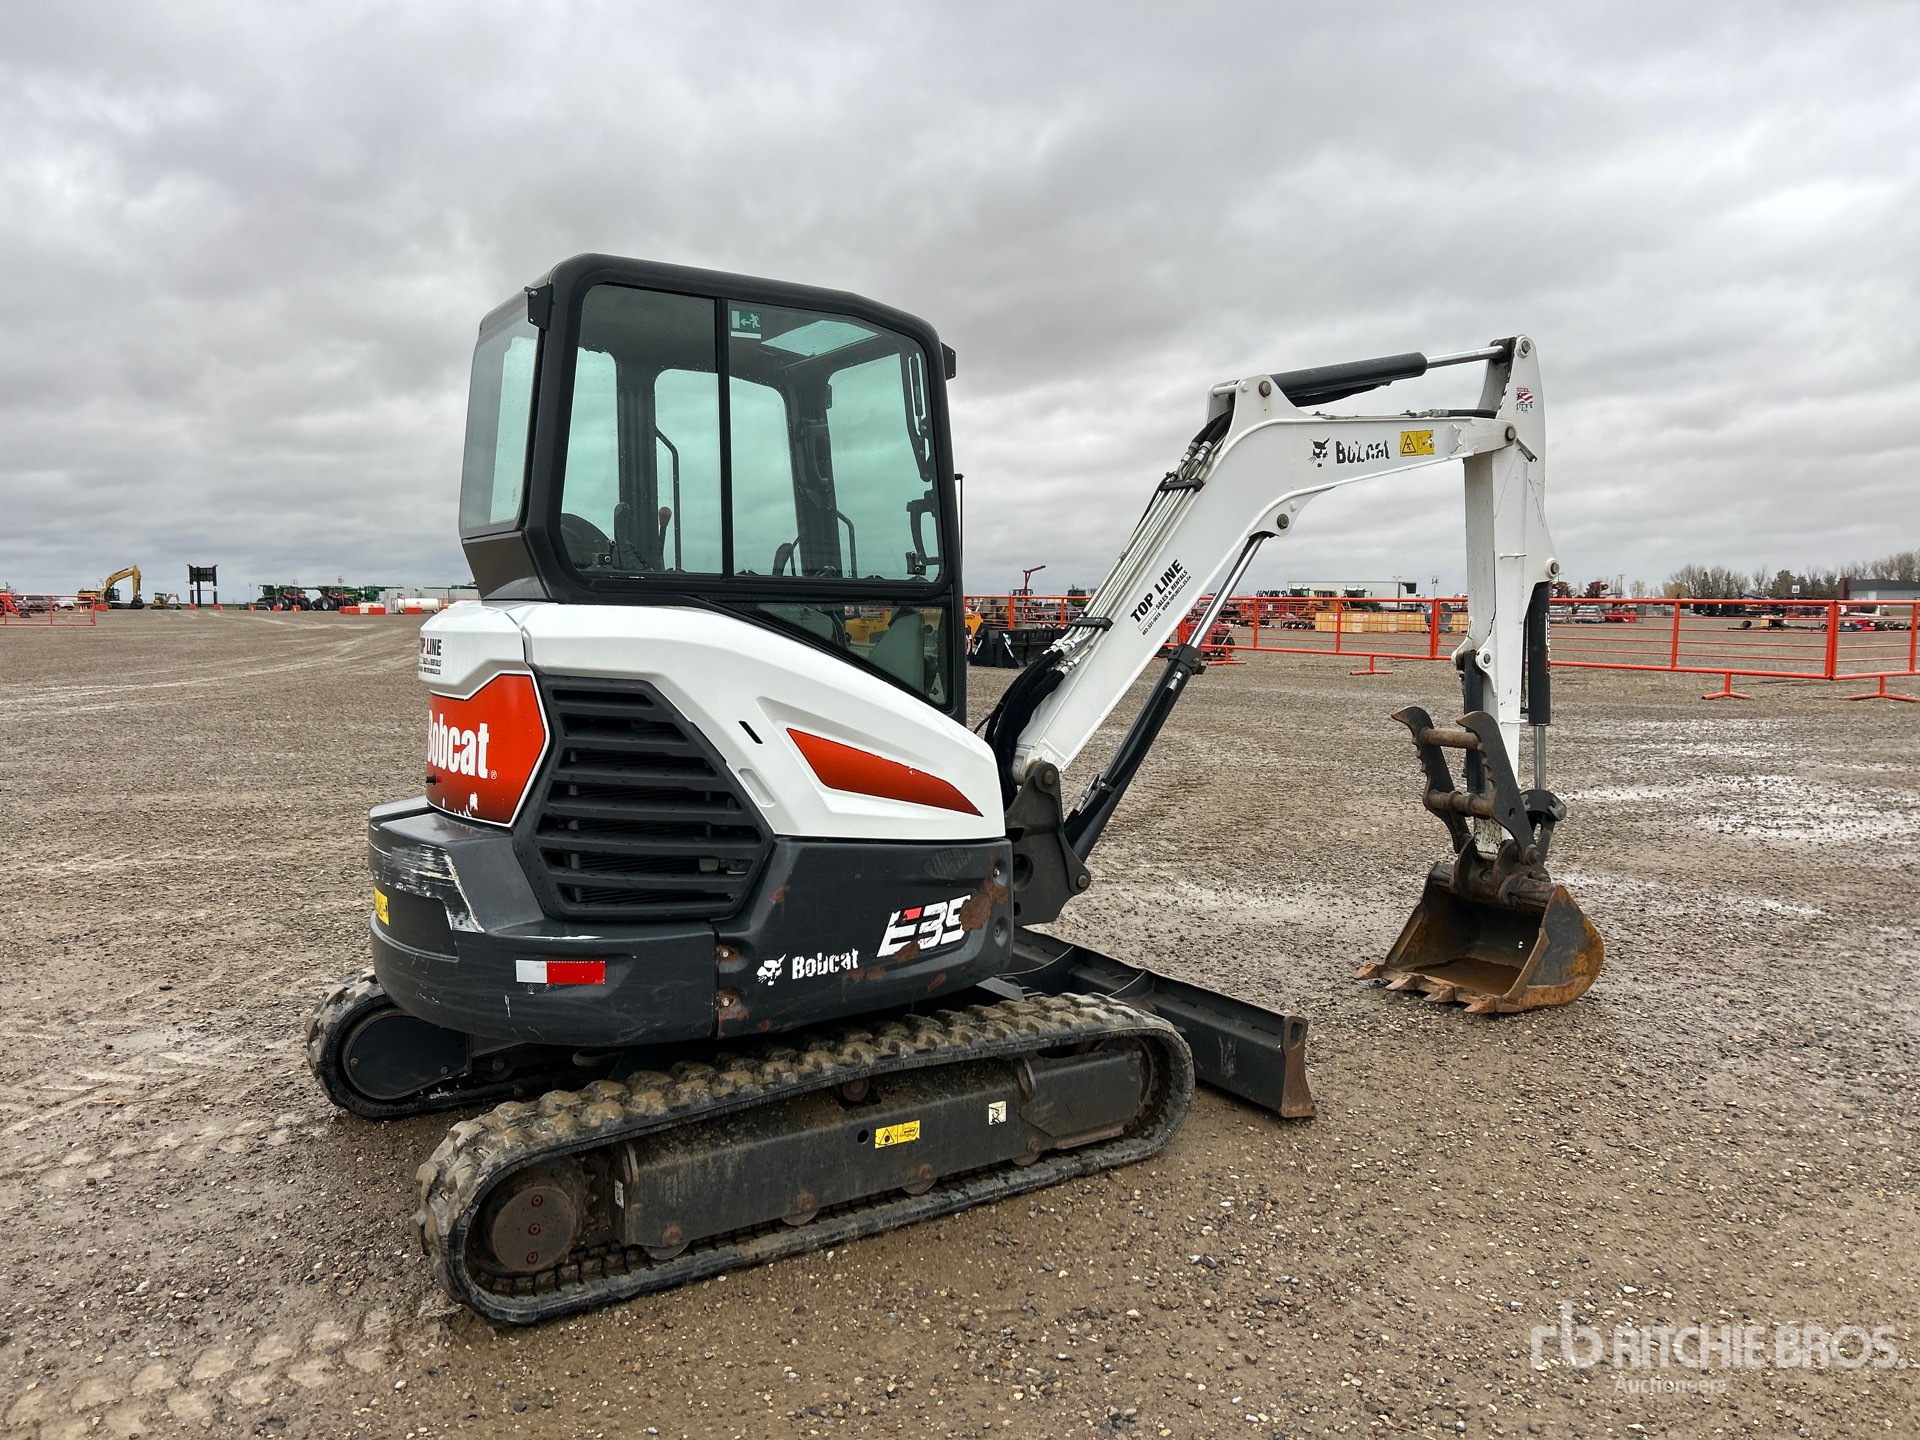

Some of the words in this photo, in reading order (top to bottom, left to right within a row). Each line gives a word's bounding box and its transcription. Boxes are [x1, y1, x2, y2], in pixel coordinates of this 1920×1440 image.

[1130, 592, 1154, 623] TOP
[1154, 559, 1183, 595] LINE
[1156, 594, 1169, 610] SALES
[1170, 569, 1188, 591] RENTALS
[426, 638, 441, 656] LINE
[427, 710, 489, 779] Bobcat
[792, 948, 859, 980] Bobcat
